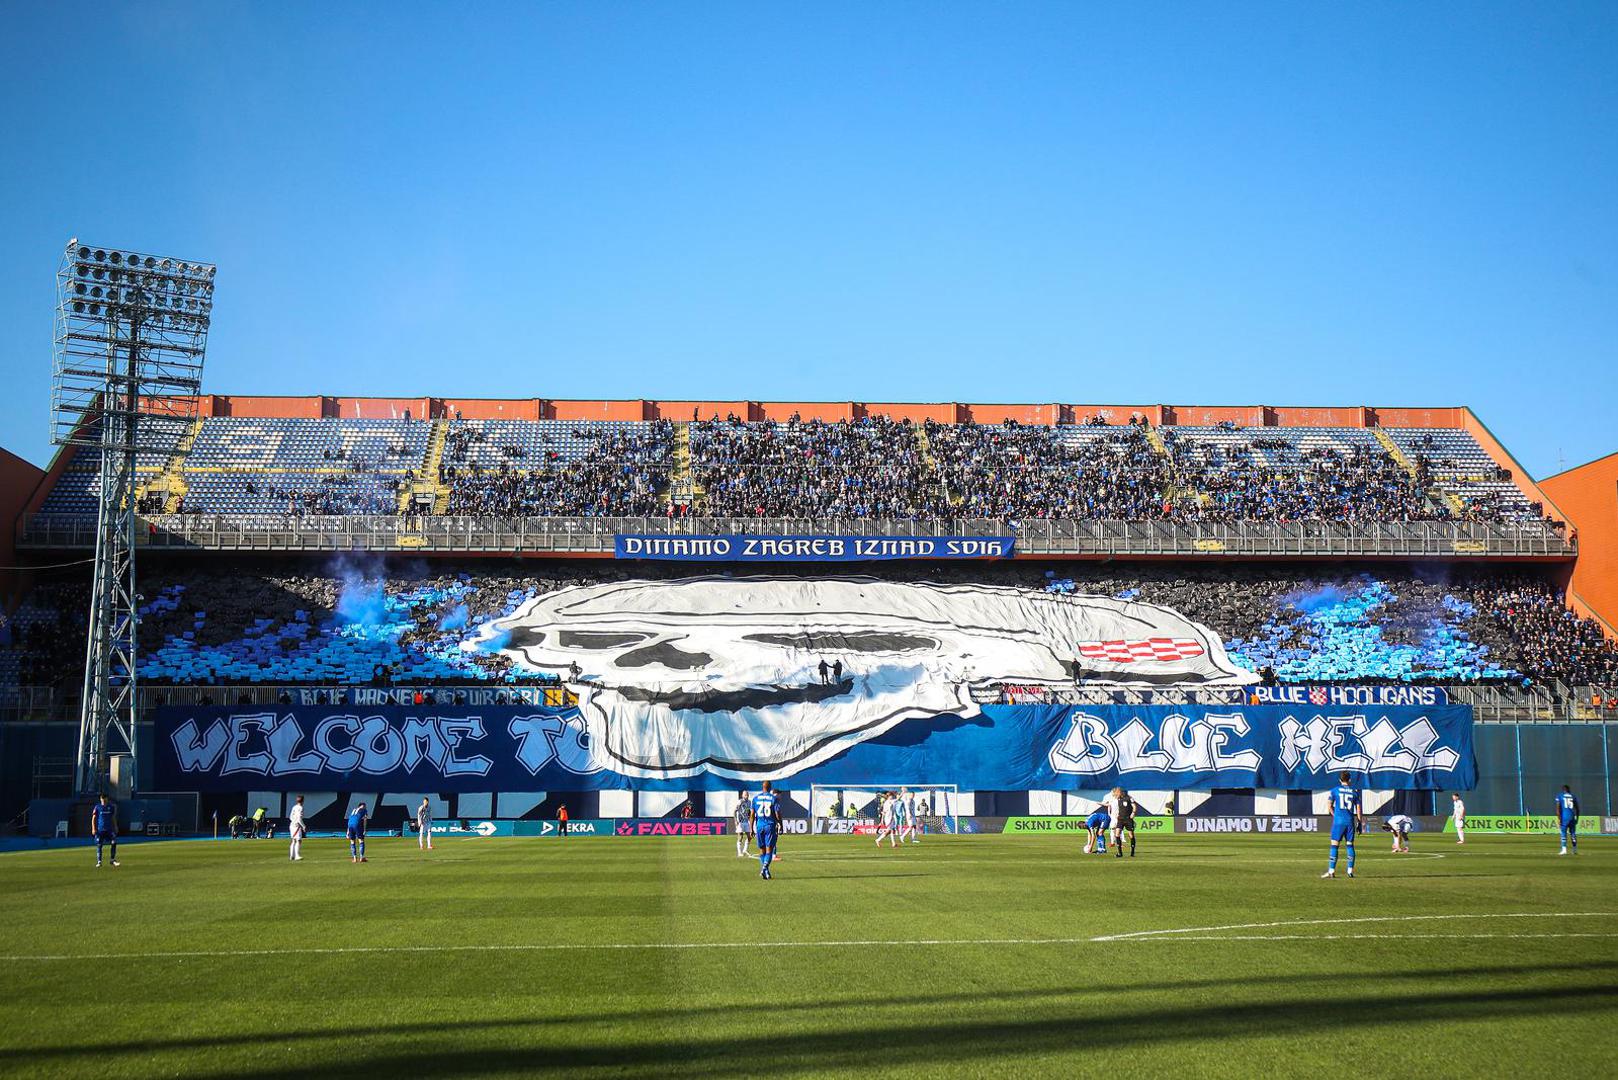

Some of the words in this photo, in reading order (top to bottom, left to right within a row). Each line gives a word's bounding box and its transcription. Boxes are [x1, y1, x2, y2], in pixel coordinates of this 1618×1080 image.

[625, 537, 731, 556] DINAMO
[744, 538, 844, 556] ZAGREB
[854, 540, 934, 556] IZNAD
[1256, 687, 1307, 703] BLUE
[1331, 687, 1435, 705] HOOLIGANS
[170, 713, 494, 777] WELCOME
[1048, 712, 1262, 773] BLUE
[1278, 714, 1461, 774] HELL
[1339, 793, 1354, 810] 15
[638, 822, 726, 835] FAVBET
[1015, 820, 1051, 830] SKINI
[1141, 820, 1164, 830] APP
[1186, 818, 1252, 832] DINAMO
[1256, 818, 1268, 832] V
[1272, 816, 1318, 832] ŽEPU!
[1462, 820, 1492, 829] KINI
[1496, 820, 1522, 829] GNK
